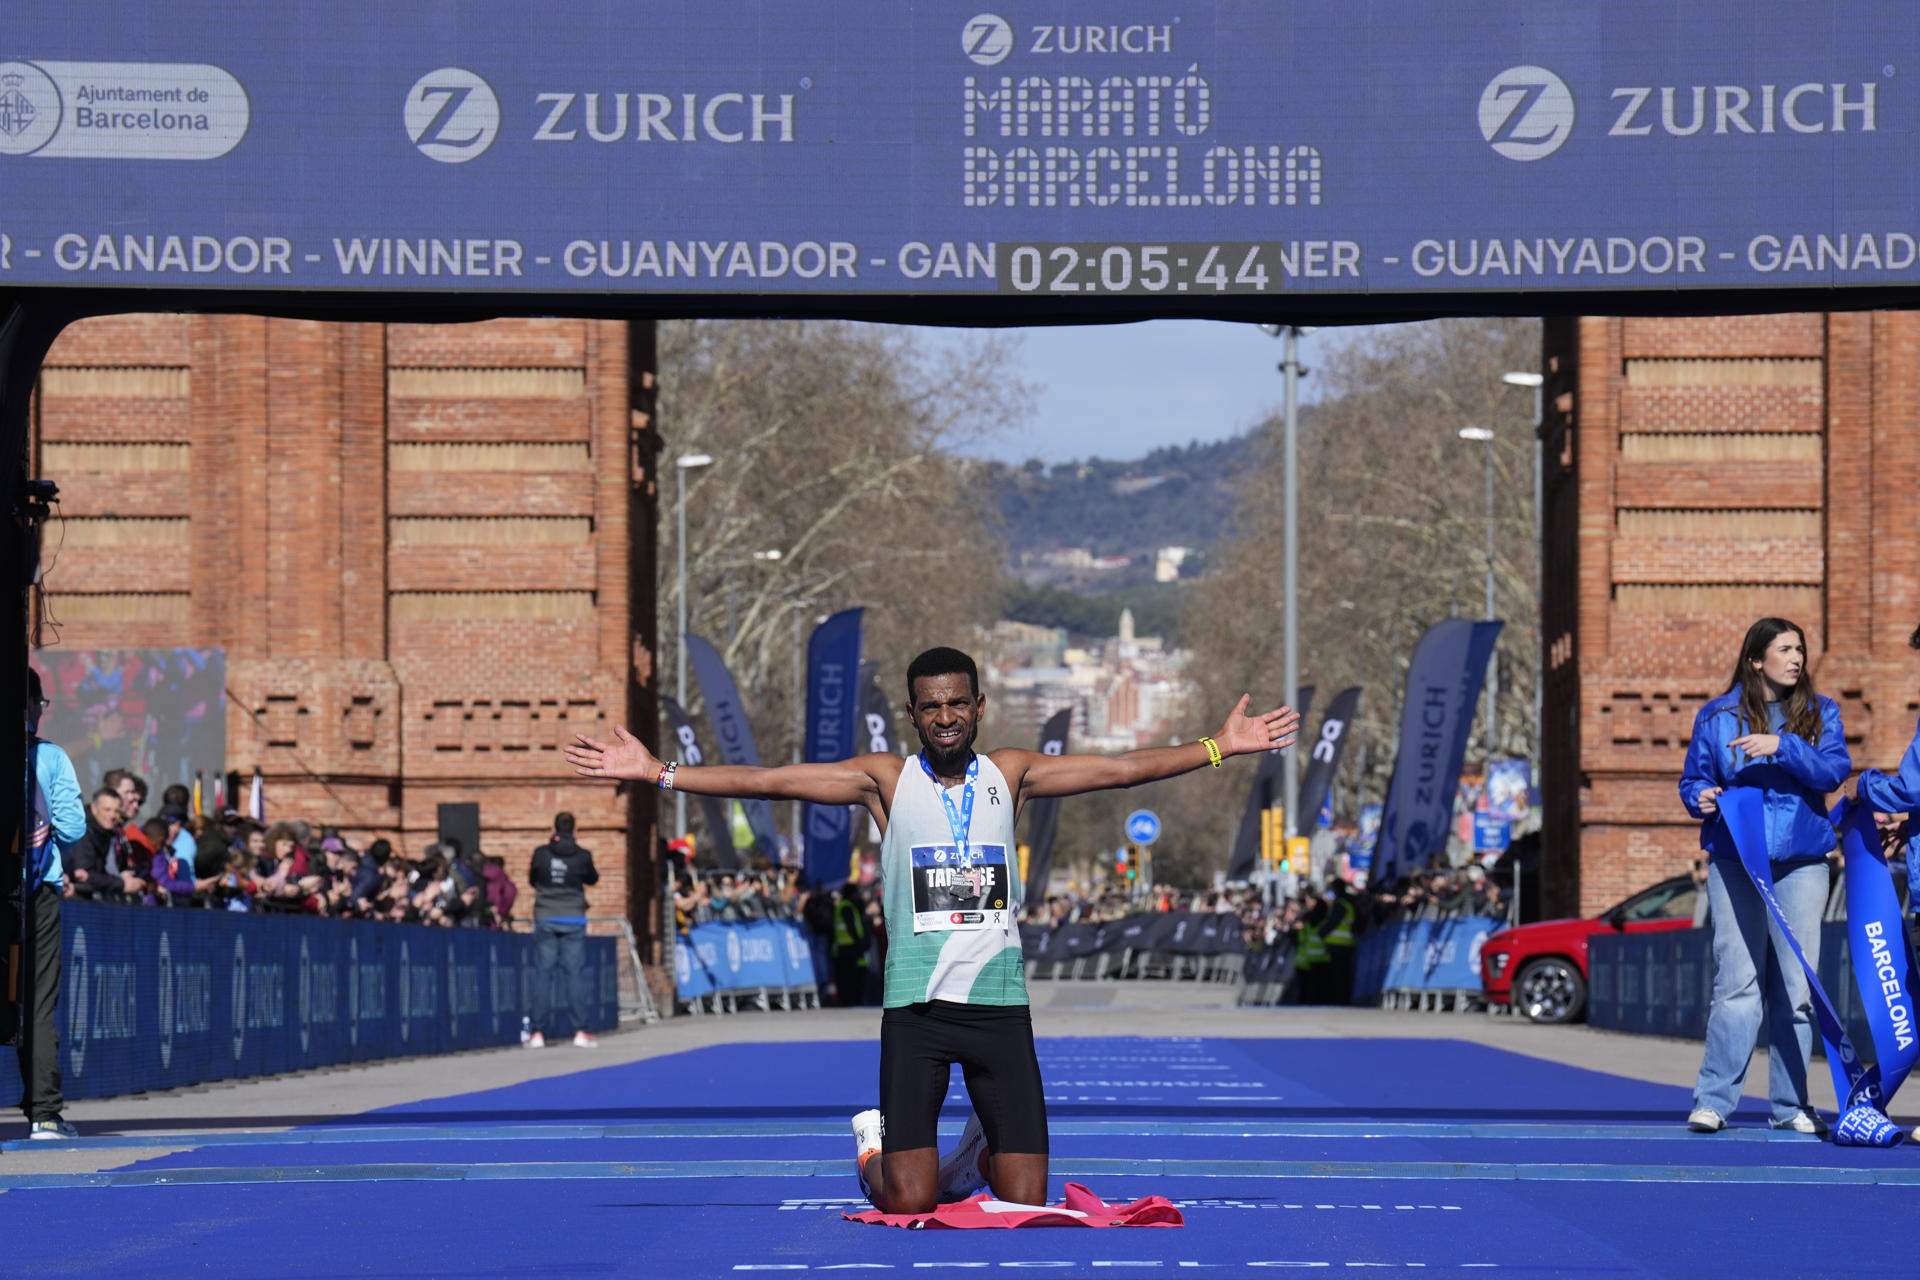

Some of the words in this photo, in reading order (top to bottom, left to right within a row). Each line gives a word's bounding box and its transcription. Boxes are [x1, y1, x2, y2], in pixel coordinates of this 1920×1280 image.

[1031, 25, 1171, 54] ZURICH
[76, 85, 182, 105] Ajuntament
[186, 88, 210, 103] de
[76, 107, 210, 131] Barcelona
[533, 93, 795, 143] ZURICH
[964, 62, 1210, 137] MARATÓ
[1607, 82, 1878, 137] ZURICH
[964, 146, 1321, 207] BARCELONA
[53, 233, 292, 275] GANADOR
[333, 239, 523, 277] WINNER
[563, 240, 857, 279] GUANYADOR
[898, 242, 997, 280] GAN
[1011, 246, 1270, 292] 02:05:44
[1411, 237, 1706, 278] GUANYADOR
[1747, 233, 1920, 274] GANAD
[817, 664, 844, 761] URICH
[1416, 686, 1447, 805] ZURICH
[1864, 920, 1914, 1052] BARCELONA
